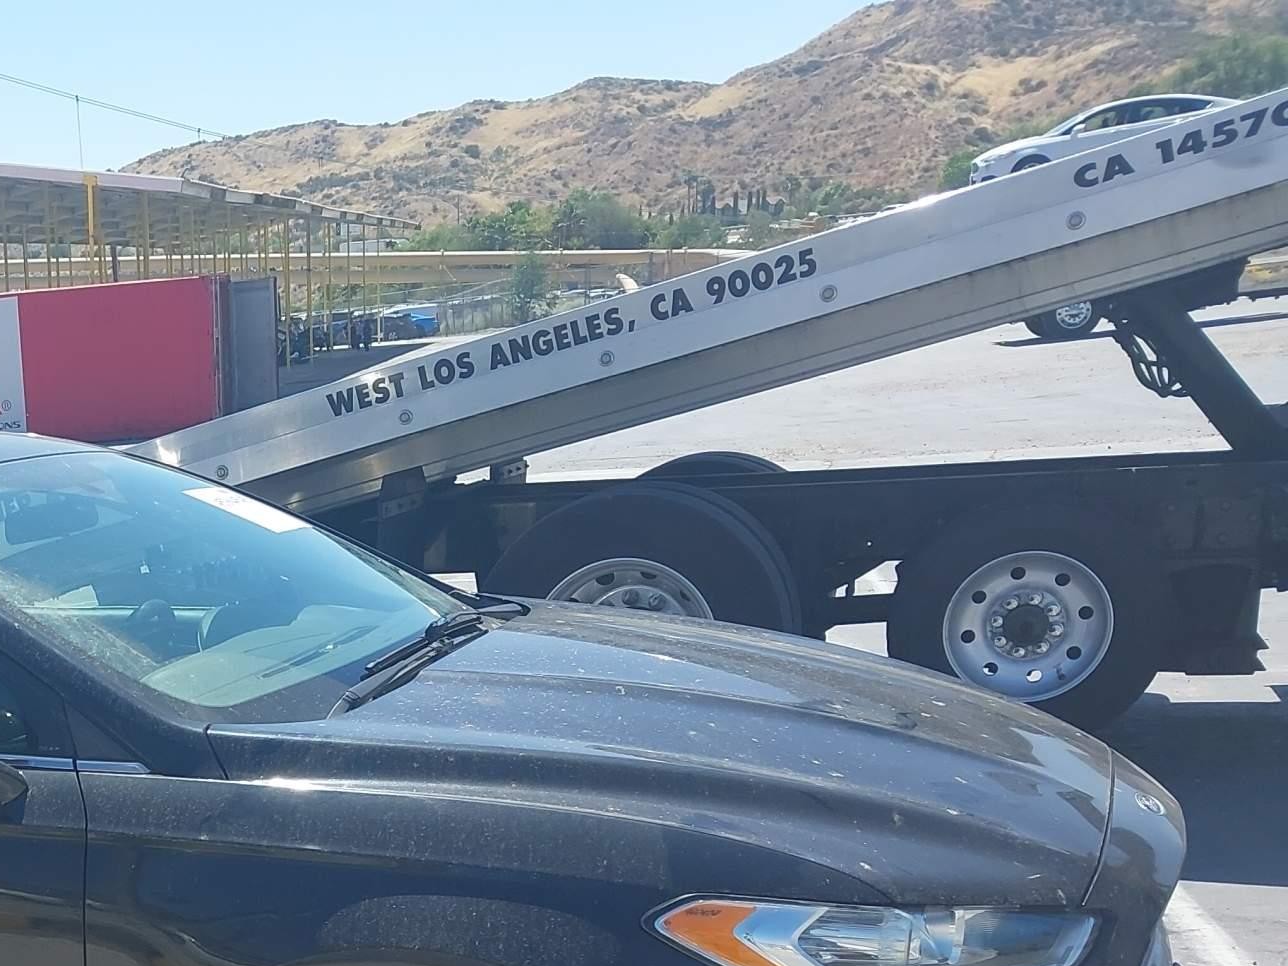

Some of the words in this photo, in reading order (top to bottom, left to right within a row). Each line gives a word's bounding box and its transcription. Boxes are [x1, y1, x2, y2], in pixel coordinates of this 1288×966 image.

[1073, 153, 1136, 188] CA
[326, 372, 406, 417] WEST
[417, 351, 475, 391] LOS
[489, 307, 637, 371] ANGELES,
[650, 288, 694, 323] CA
[706, 247, 817, 305] 90025
